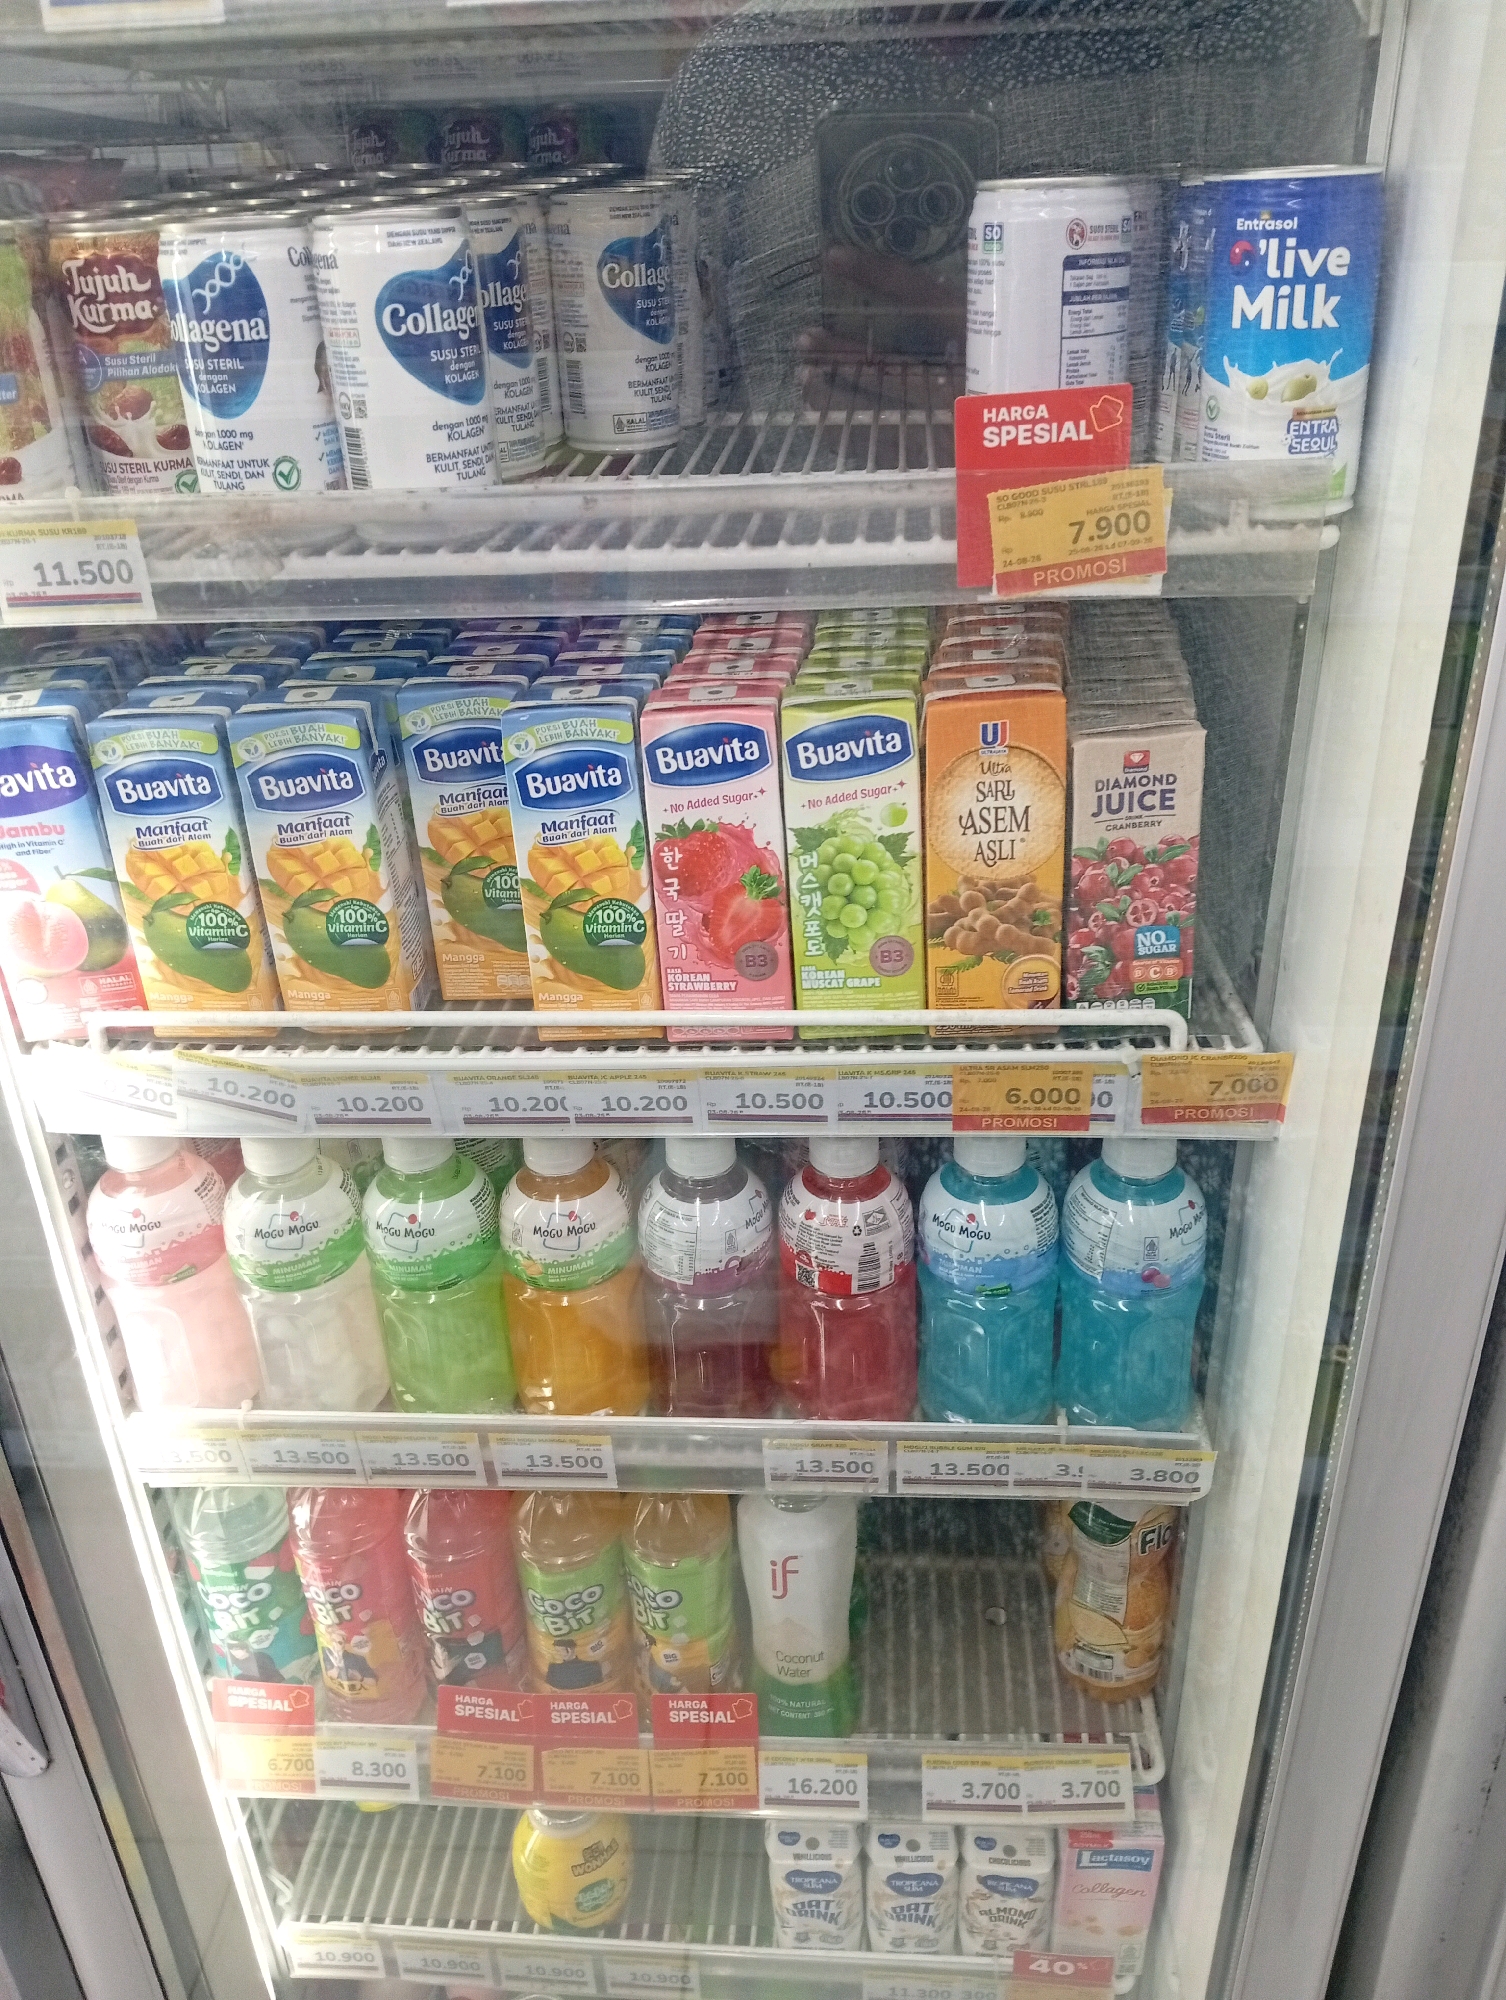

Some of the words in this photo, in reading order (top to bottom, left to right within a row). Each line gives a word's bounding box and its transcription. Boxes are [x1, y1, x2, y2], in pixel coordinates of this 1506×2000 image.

[1236, 217, 1298, 231] Entrasol
[62, 259, 151, 295] Tujuh
[67, 294, 155, 334] Kurma
[1231, 283, 1341, 330] Milk
[169, 310, 268, 352] ollagena
[104, 356, 127, 366] Susu
[430, 348, 458, 362] SUSU
[207, 357, 244, 370] STERIL
[107, 366, 140, 377] Pilihan
[983, 404, 1049, 423] HARGA
[432, 420, 464, 431] dengan
[983, 420, 1093, 448] SPESIAL
[426, 445, 480, 463] BERMANFAAT
[119, 460, 151, 474] STERIL
[153, 457, 193, 472] KURMA
[237, 458, 270, 469] UNTUK
[244, 470, 265, 480] DAN
[456, 467, 486, 481] TULANG
[213, 480, 245, 490] TULANG
[38, 528, 60, 536] SUSU
[1068, 510, 1151, 545] 7.900
[33, 559, 134, 587] 11.500
[1033, 558, 1127, 586] PROMOSI
[456, 698, 489, 709] BUAH
[290, 724, 326, 735] BUAH
[562, 718, 596, 729] BUAH
[146, 729, 179, 740] BUAH
[655, 737, 760, 774] Buavita
[796, 731, 902, 770] Buavita
[980, 760, 1012, 776] Ultra
[0, 763, 77, 798] avita
[257, 768, 354, 800] Buavita
[525, 765, 622, 799] Buavita
[1095, 773, 1177, 793] DIAMOND
[115, 773, 212, 805] Buavita
[807, 798, 824, 809] No
[825, 790, 858, 807] Added
[860, 784, 892, 800] Sugar
[440, 803, 463, 814] Buah
[669, 803, 685, 814] No
[686, 796, 721, 811] Added
[722, 792, 754, 806] Sugar
[1091, 788, 1176, 818] JUICE
[276, 815, 351, 837] Manfaat
[541, 813, 615, 835] Manfaat
[959, 805, 1031, 836] ASEM
[1105, 820, 1162, 832] CRANBERRY
[135, 820, 209, 842] Manfaat
[188, 832, 212, 842] Alam
[279, 833, 305, 844] Buah
[306, 830, 327, 841] dari
[328, 827, 353, 837] Alam
[542, 833, 568, 843] Buah
[569, 829, 591, 840] dari
[592, 826, 617, 836] Alam
[974, 839, 1016, 867] ASLI
[660, 846, 689, 961] 한국딸기
[199, 913, 240, 927] 100%
[338, 909, 378, 923] 100%
[595, 908, 637, 924] 100%
[236, 924, 248, 938] C
[375, 920, 388, 932] C
[632, 919, 645, 933] C
[1136, 930, 1166, 948] NO
[879, 950, 904, 964] B3
[1138, 944, 1177, 956] SUGAR
[744, 954, 769, 968] B3
[667, 972, 711, 983] KOREAN
[801, 970, 845, 980] KOREAN
[668, 981, 737, 992] STRAWBERRY
[801, 978, 844, 989] MUSCAT
[846, 977, 881, 988] GRAPE
[287, 989, 331, 1001] Mangga
[538, 992, 583, 1003] Mangga
[207, 1077, 296, 1109] 10.200
[1208, 1077, 1279, 1096] 7.000
[601, 1095, 688, 1112] 10.200
[735, 1092, 824, 1109] 10.500
[863, 1091, 952, 1109] 10.500
[1005, 1087, 1081, 1105] 6.000
[336, 1096, 424, 1112] 10.200
[1174, 1107, 1254, 1120] PROMOSI
[981, 1117, 1058, 1128] PROMOSI
[273, 1449, 350, 1465] 13.500
[392, 1452, 470, 1467] 13.500
[525, 1454, 604, 1469] 13.500
[795, 1459, 874, 1474] 13.500
[930, 1463, 1010, 1476] 13.500
[1130, 1468, 1200, 1483] 3.800
[775, 1650, 824, 1664] Coconut
[776, 1664, 812, 1679] Water
[227, 1695, 293, 1712] SPESIAL
[455, 1695, 494, 1706] HARGA
[550, 1701, 589, 1710] HARGA
[669, 1699, 708, 1709] HARGA
[790, 1698, 826, 1709] NATURAL
[454, 1705, 520, 1722] SPESIAL
[551, 1711, 616, 1724] SPESIAL
[669, 1710, 735, 1723] SPESIAL
[267, 1758, 315, 1772] 6.700
[351, 1761, 407, 1778] 8.300
[477, 1765, 526, 1782] 7.100
[590, 1771, 640, 1786] 7.100
[698, 1772, 748, 1787] 7.100
[453, 1786, 510, 1801] PROMOSI
[787, 1777, 858, 1796] 16.200
[962, 1782, 1021, 1800] 3.700
[1061, 1780, 1121, 1798] 3.700
[568, 1795, 626, 1806] PROMOSI
[677, 1798, 735, 1808] PROMOSI
[1079, 1850, 1150, 1867] Lactasoy
[891, 1879, 939, 1887] TROPICANA
[1071, 1883, 1148, 1899] Collagen
[792, 1900, 836, 1911] OAT
[891, 1902, 935, 1914] OAT
[979, 1907, 1038, 1921] ALMOND
[989, 1915, 1028, 1929] DRINK
[315, 1951, 375, 1963] 10.900
[420, 1957, 480, 1971] 10.900
[524, 1964, 585, 1978] 10.900
[630, 1972, 691, 1985] 10.900
